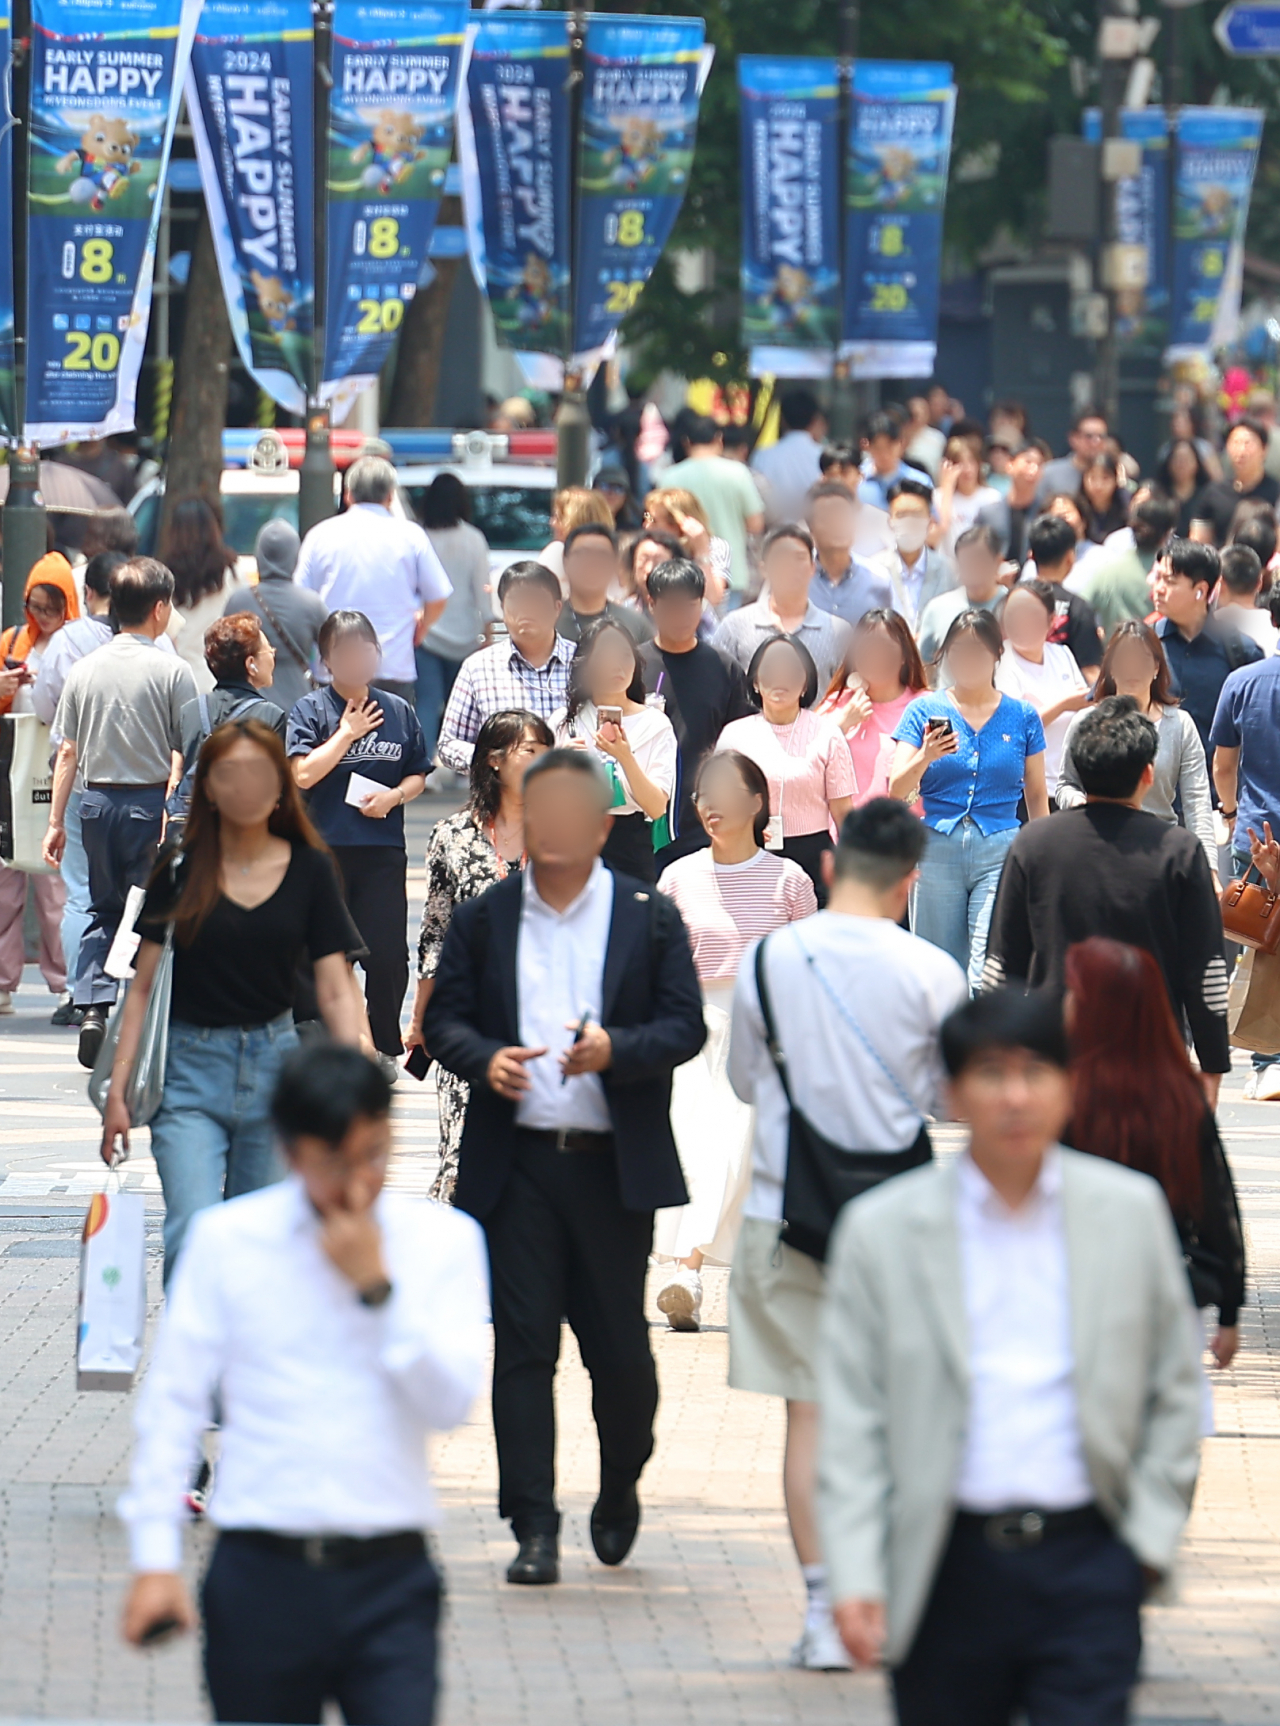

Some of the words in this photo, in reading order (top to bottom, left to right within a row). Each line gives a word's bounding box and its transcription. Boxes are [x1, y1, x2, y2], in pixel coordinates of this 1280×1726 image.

[45, 48, 94, 65] EARLY
[96, 50, 163, 69] SUMMER
[223, 51, 272, 71] 2024
[343, 54, 388, 68] EARLY
[389, 54, 450, 70] SUMMER
[44, 64, 163, 97] HAPPY
[343, 67, 448, 94] HAPPY
[592, 80, 686, 104] HAPPY
[271, 76, 292, 158] EARLY
[225, 74, 279, 270] HAPPY
[769, 120, 804, 264] HAPPY
[275, 159, 298, 273] SUMMER
[618, 209, 645, 247] 8
[368, 217, 400, 259] 8
[80, 238, 114, 284] 8
[356, 298, 405, 334] 20
[62, 331, 120, 371] 20
[34, 790, 51, 801] dut
